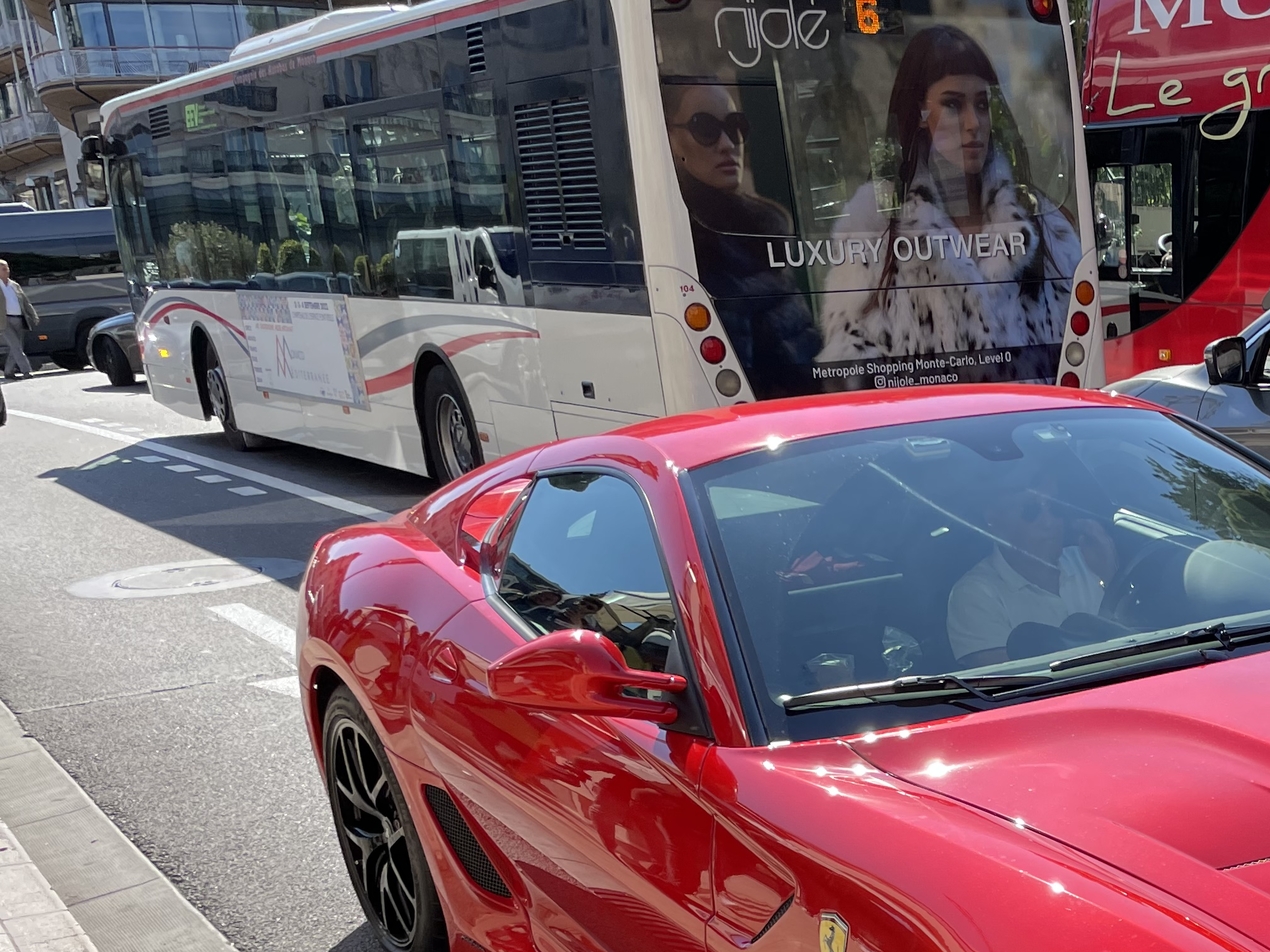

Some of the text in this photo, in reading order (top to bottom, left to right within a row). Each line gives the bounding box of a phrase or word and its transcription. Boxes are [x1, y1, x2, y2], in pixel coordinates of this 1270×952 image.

[856, 0, 880, 34] 6
[1106, 50, 1192, 116] Le
[766, 231, 1027, 268] LUXURY OUTWEAR
[679, 285, 695, 293] 104
[812, 352, 1012, 378] Metropole Shopping Monte-Carlo, Level 0
[888, 372, 959, 388] nijole_monaco
